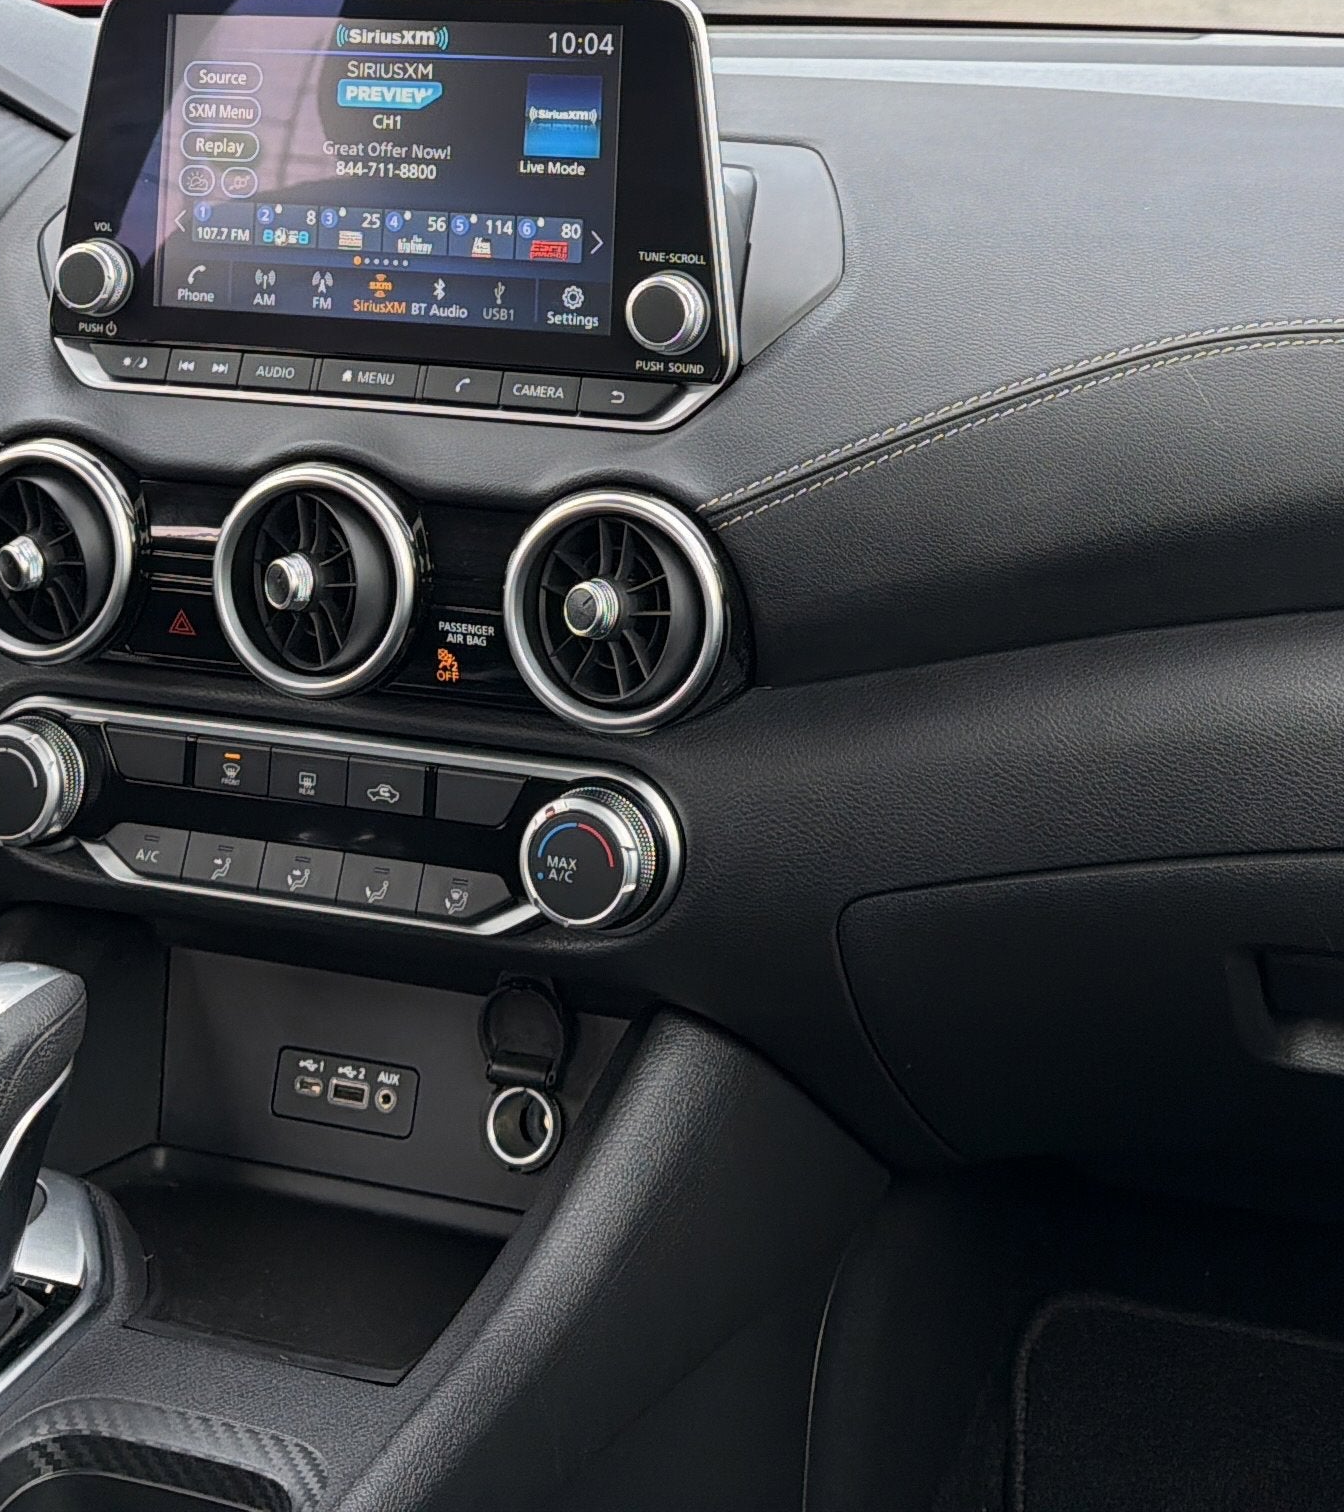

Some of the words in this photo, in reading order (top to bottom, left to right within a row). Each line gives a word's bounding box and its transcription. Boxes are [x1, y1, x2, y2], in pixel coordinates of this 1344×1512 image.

[548, 32, 614, 55] 10:04
[199, 70, 246, 85] Source
[347, 61, 433, 79] SIRIUSXM
[346, 86, 433, 103] PREVIEW
[189, 104, 215, 118] SXM
[219, 105, 253, 120] Menu
[373, 114, 401, 129] CH1
[196, 138, 244, 156] Replay
[323, 142, 364, 157] Great
[371, 142, 407, 158] Offer
[412, 144, 451, 159] Now!
[336, 161, 436, 180] 844-711-8800
[519, 160, 544, 174] Live
[548, 162, 585, 175] Mode
[306, 210, 317, 225] 8
[361, 213, 381, 228] 25
[427, 216, 446, 232] 56
[94, 222, 112, 232] VOL
[196, 226, 228, 240] 107.7
[230, 228, 250, 241] FM
[486, 220, 513, 235] 114
[561, 224, 581, 239] 80
[177, 288, 214, 303] Phone
[253, 293, 276, 306] AM
[312, 296, 332, 310] FM
[353, 299, 406, 314] SiriusXM
[411, 303, 425, 316] BT
[429, 303, 468, 318] Audio
[482, 308, 515, 321] USB1
[546, 311, 599, 329] Settings
[79, 322, 103, 333] PUSH
[255, 366, 295, 379] AUDIO
[635, 360, 664, 372] PUSH
[668, 362, 704, 374] SOUND
[357, 372, 395, 385] MENU
[512, 383, 564, 399] CAMERA
[438, 621, 495, 636] PASSENGER
[446, 633, 464, 644] AIR
[466, 635, 487, 647] BAG
[436, 670, 459, 683] OFF
[135, 848, 160, 863] A/C
[546, 854, 577, 871] MAX
[547, 868, 573, 884] A/C
[377, 1071, 400, 1086] AUX
